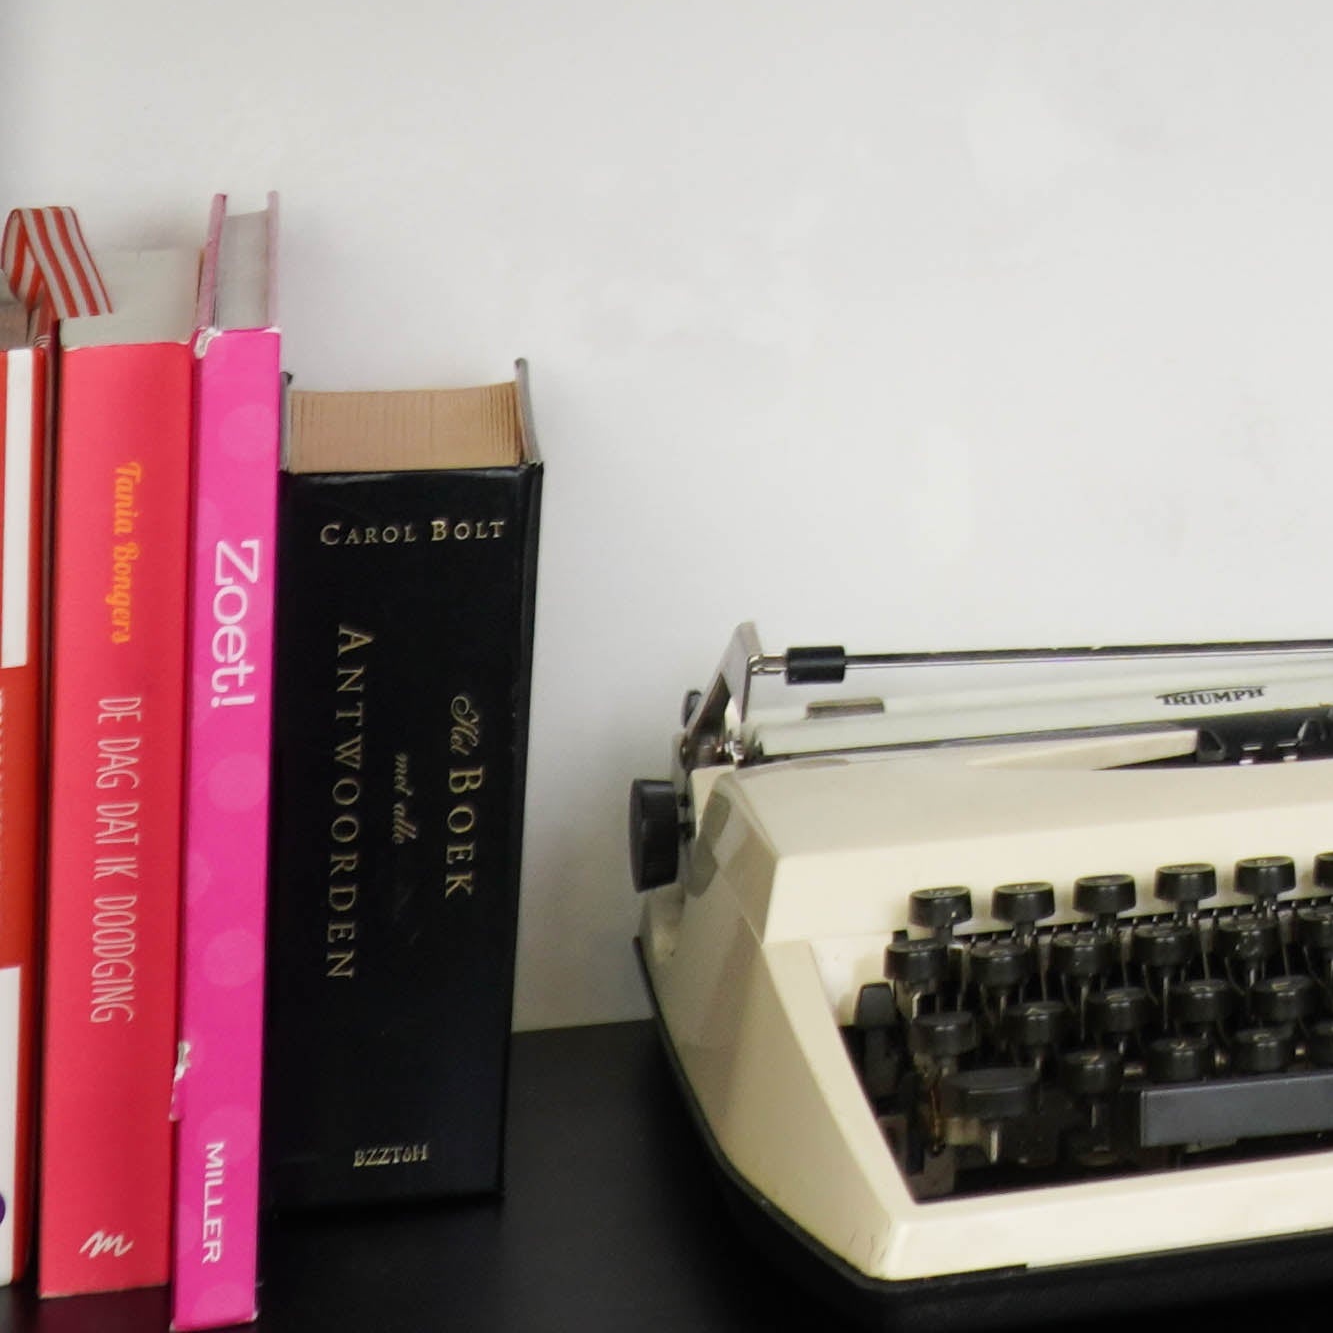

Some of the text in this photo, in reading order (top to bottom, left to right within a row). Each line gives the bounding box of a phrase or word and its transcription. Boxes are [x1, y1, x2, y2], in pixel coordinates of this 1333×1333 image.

[106, 461, 142, 644] Tania Bongers
[430, 520, 505, 542] BOLT
[210, 538, 263, 709] Zoet!
[1155, 685, 1267, 706] TRIUMPH
[90, 696, 142, 1023] DE DAG DAT IK DOODGING
[201, 1140, 226, 1264] MILLER
